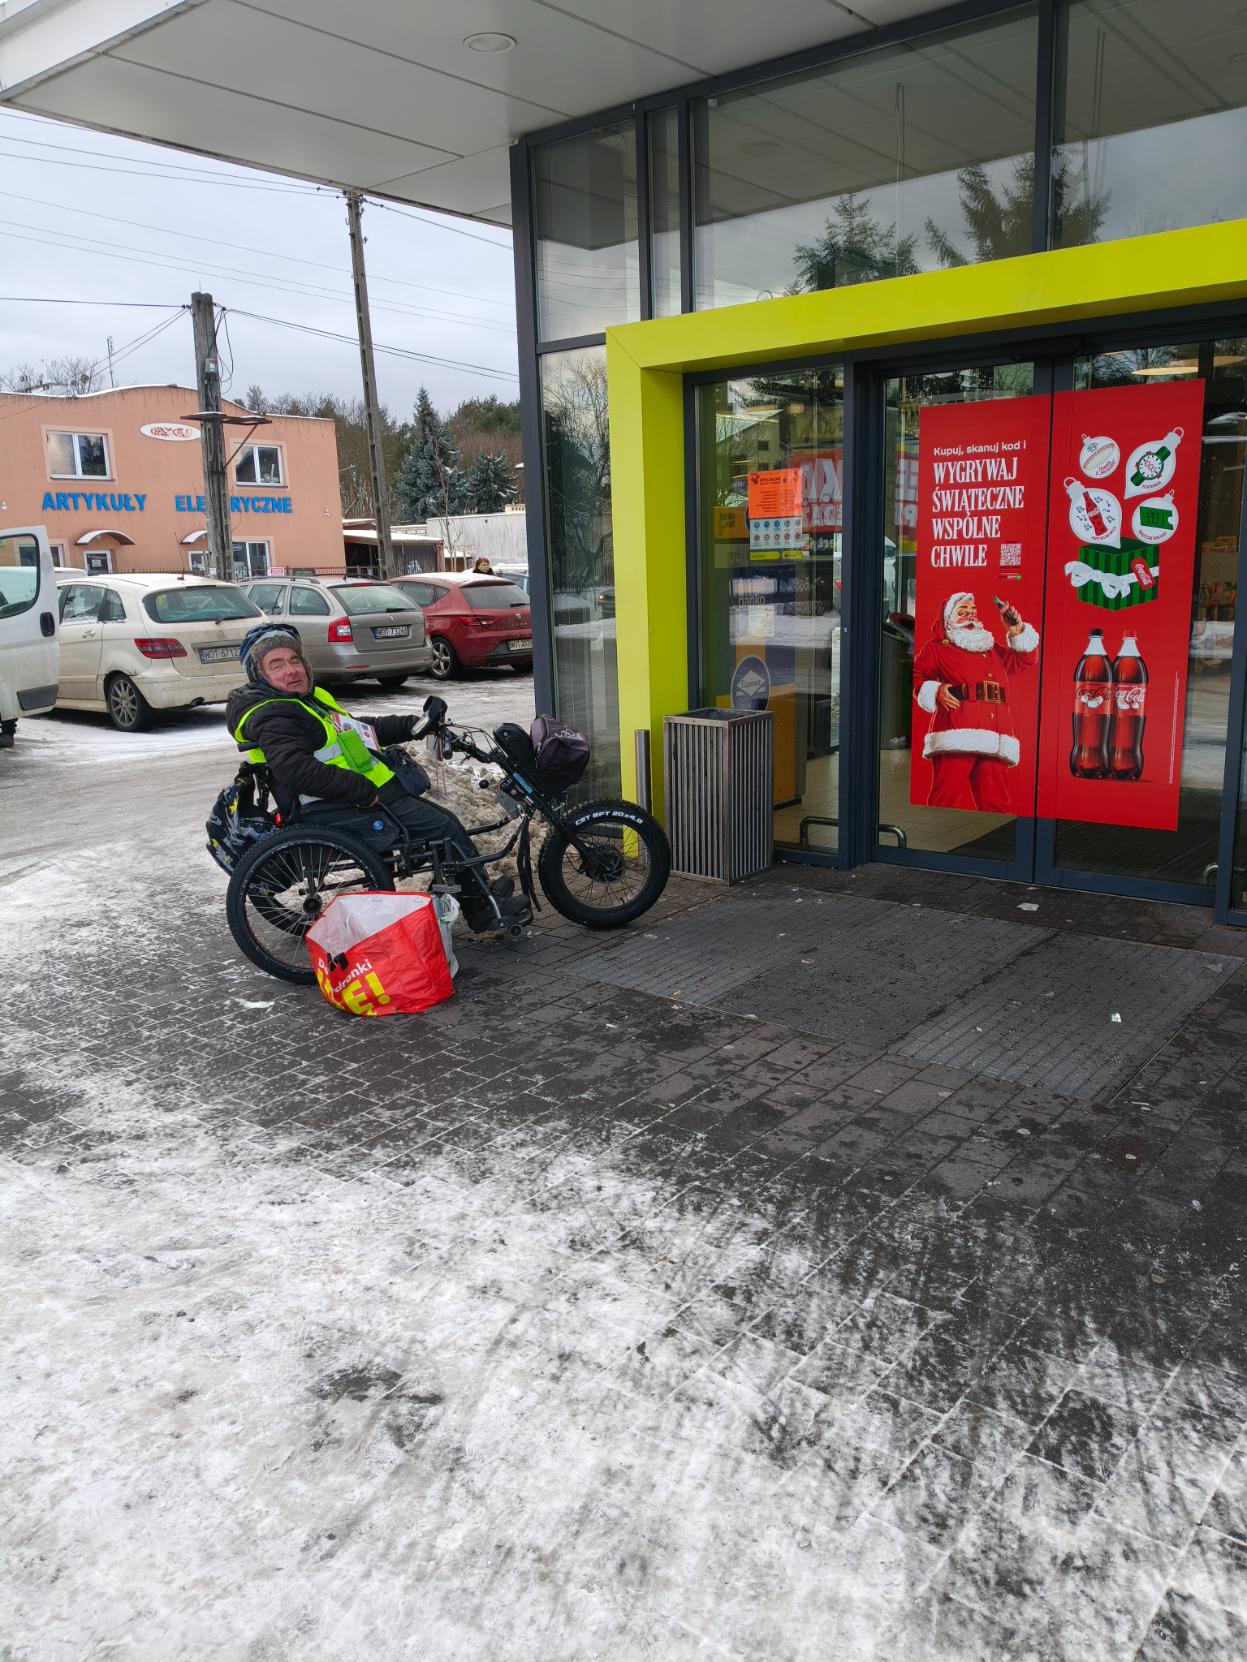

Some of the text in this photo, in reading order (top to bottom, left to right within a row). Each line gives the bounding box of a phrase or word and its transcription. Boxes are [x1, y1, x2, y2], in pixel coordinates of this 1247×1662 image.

[933, 446, 964, 456] Kupuj,
[966, 443, 999, 454] skanuj
[1001, 441, 1020, 451] kod
[933, 457, 1018, 484] WYGRYWAJ
[42, 491, 293, 514] ARTYKUŁY ELERYCZNE
[932, 486, 1025, 517] ŚWIĄTECZNE
[932, 514, 1001, 540] WSPÓLNE
[931, 544, 988, 568] CHWILE
[221, 647, 241, 658] 6712
